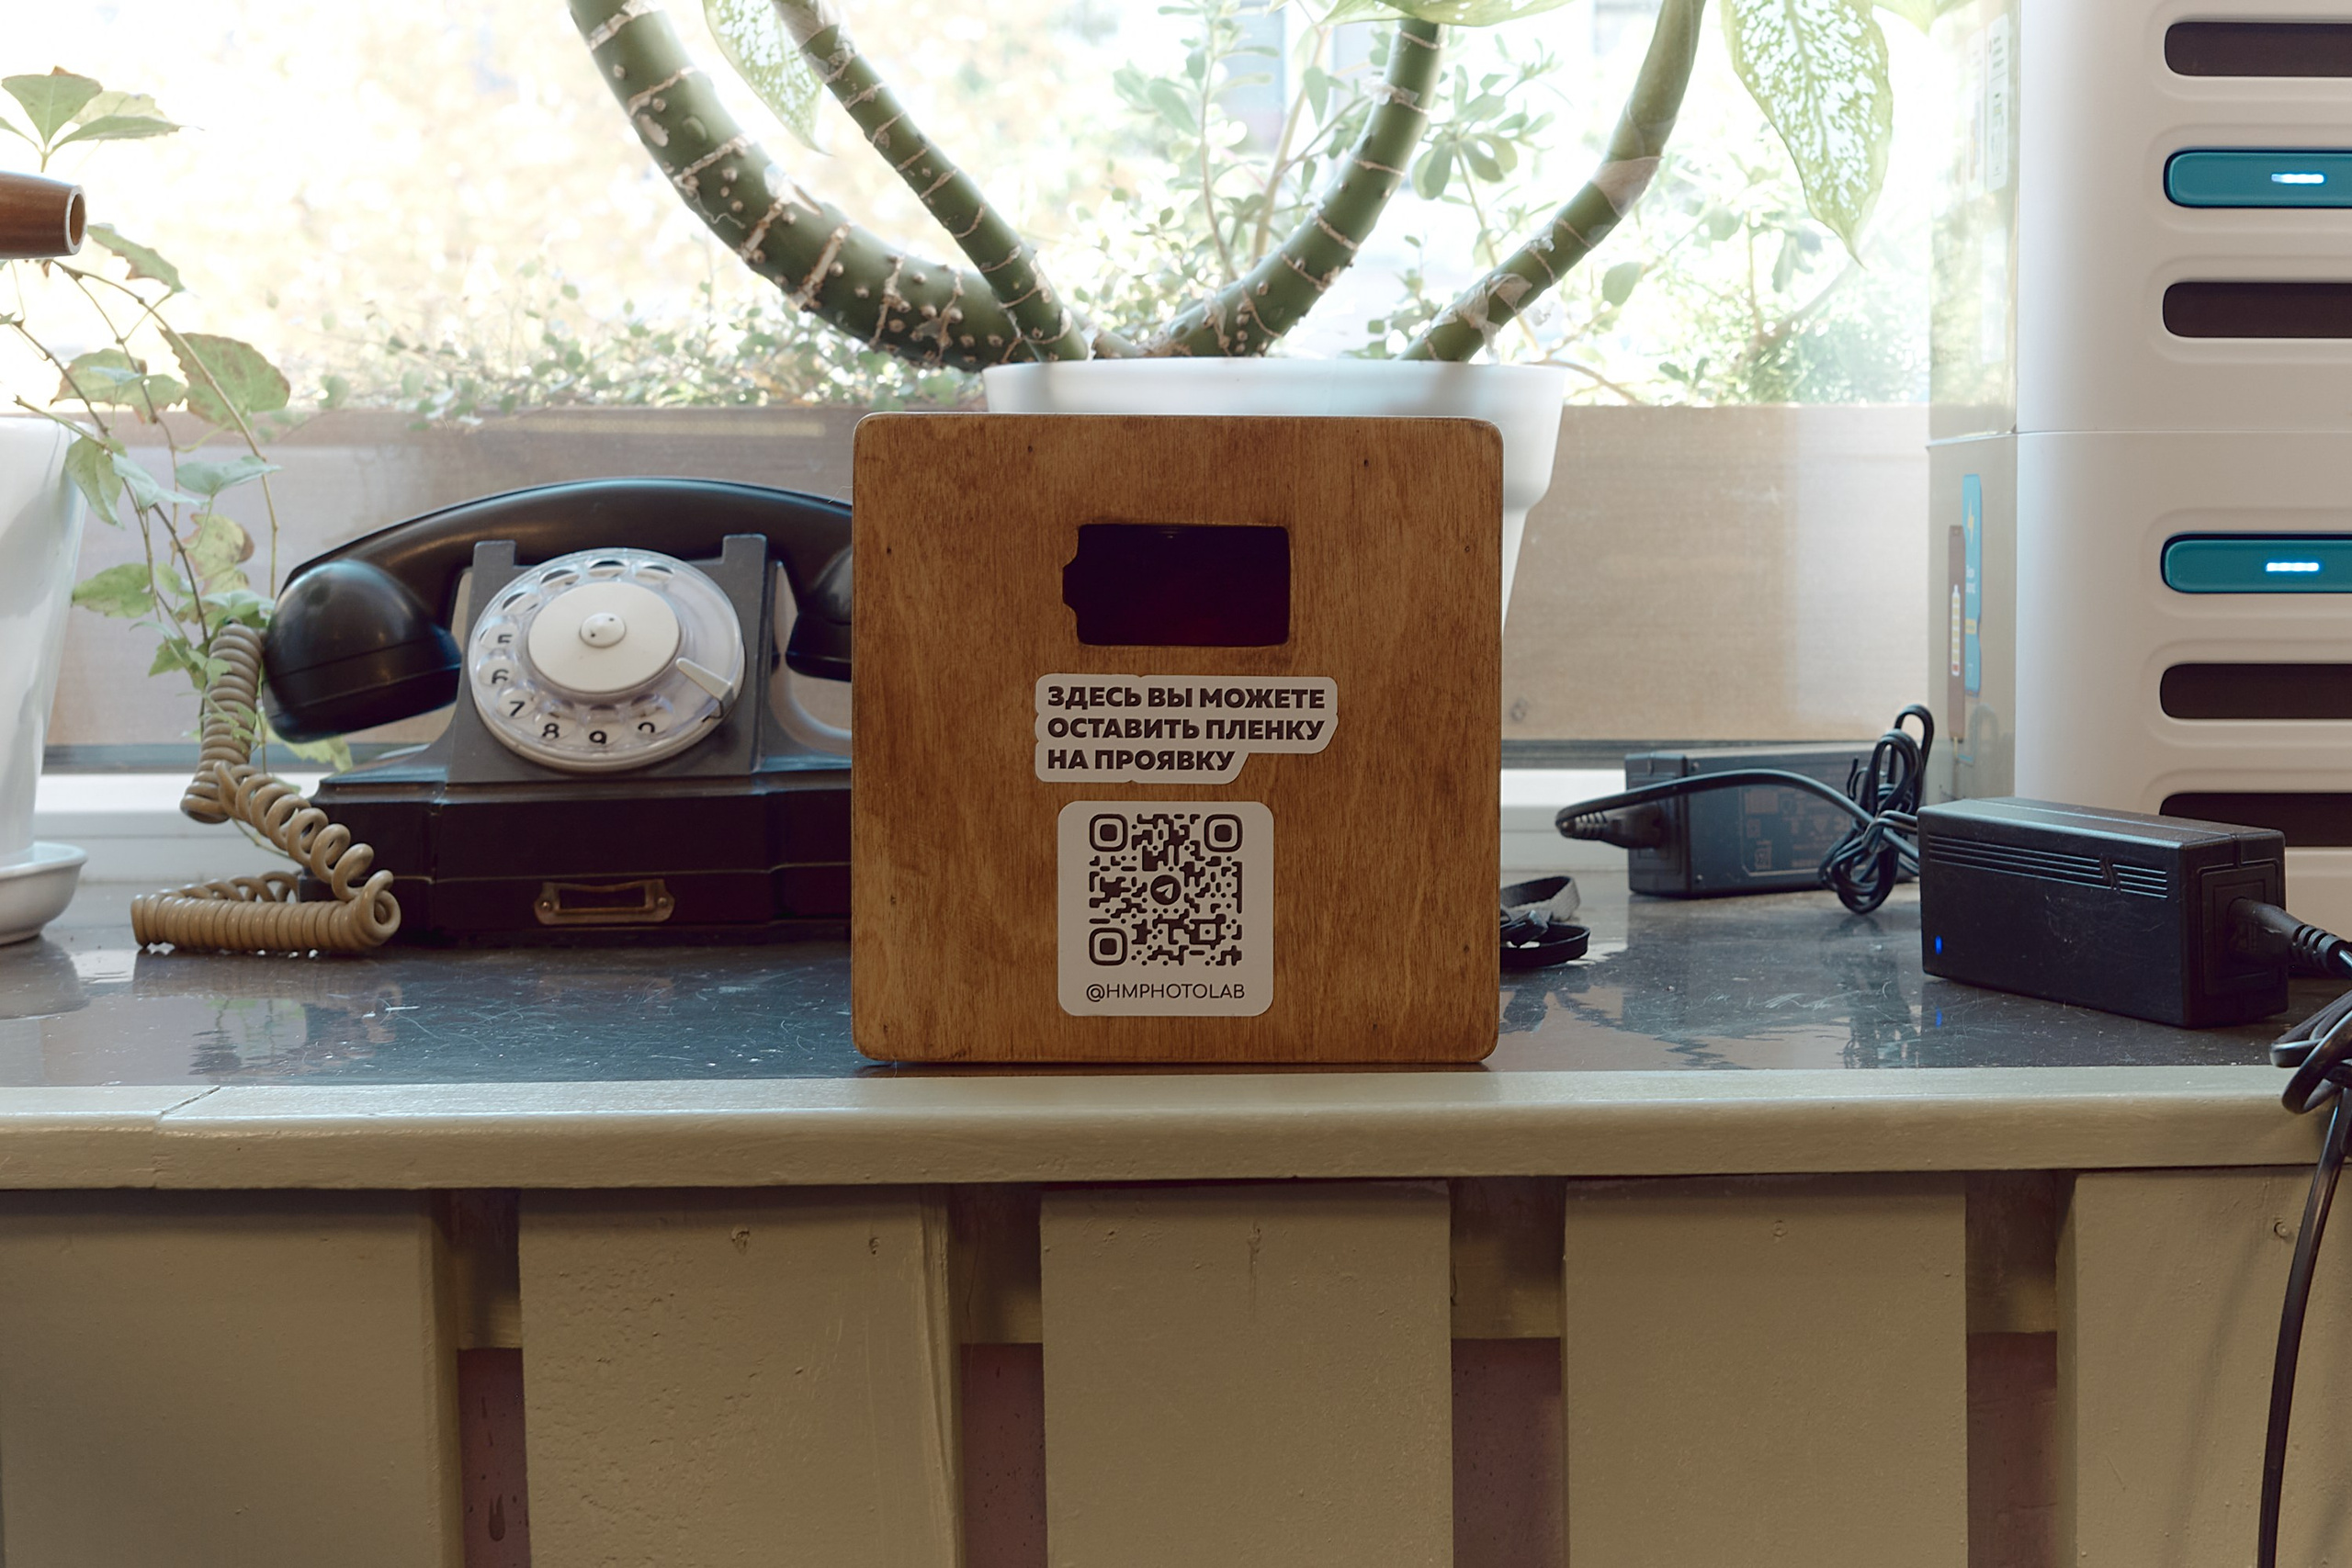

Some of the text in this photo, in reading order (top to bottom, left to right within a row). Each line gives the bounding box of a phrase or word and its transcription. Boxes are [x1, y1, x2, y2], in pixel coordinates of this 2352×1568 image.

[1047, 685, 1326, 710] ЗДЕСЬ ВЫ МОЖЕТЕ
[509, 700, 526, 717] 7
[541, 722, 560, 739] 8
[1047, 716, 1326, 741] ОСТАВИТЬ ПЛЕНКУ
[1047, 749, 1236, 772] НА ПРОЯВКУ
[1085, 983, 1246, 1003] @HMPHOTOLAB
